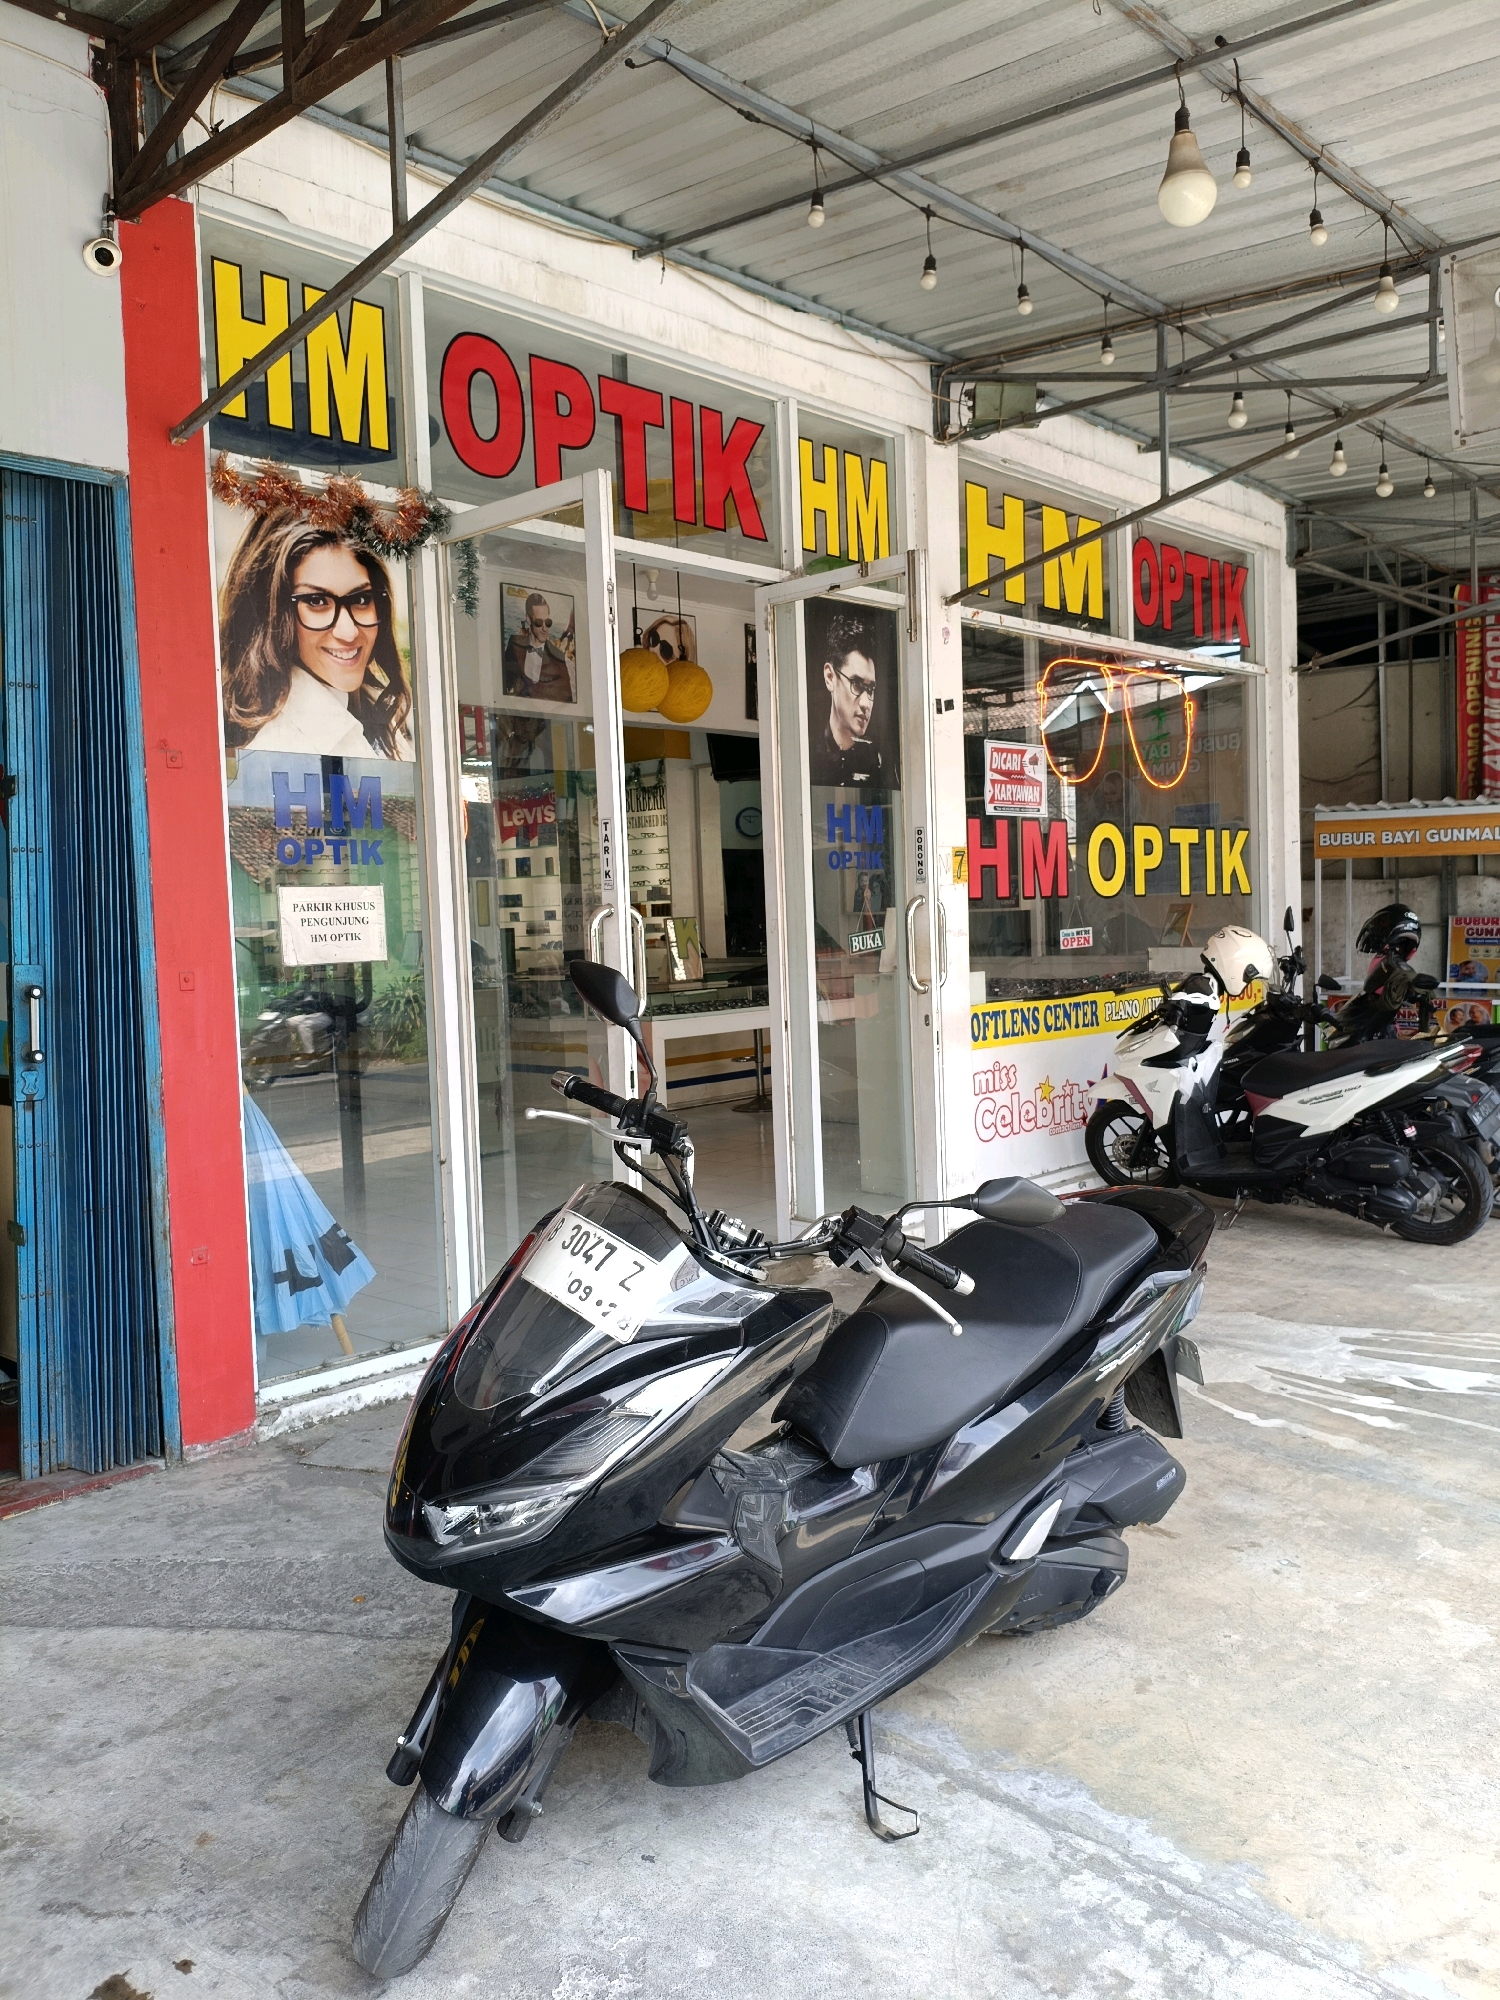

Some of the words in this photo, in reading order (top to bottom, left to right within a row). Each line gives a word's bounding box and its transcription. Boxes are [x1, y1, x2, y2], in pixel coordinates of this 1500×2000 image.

[211, 255, 391, 453] HM
[440, 332, 768, 542] OPTIK
[799, 436, 890, 563] HM
[965, 480, 1104, 620] HM
[1132, 536, 1250, 647] OPTIK
[991, 751, 1021, 771] DICARI
[271, 771, 384, 830] HM
[994, 783, 1040, 802] KARYAWAN
[826, 803, 883, 844] HM
[1319, 832, 1377, 847] BUBUR
[1381, 829, 1420, 845] BAYI
[277, 838, 384, 866] OPTIK
[603, 822, 612, 879] TARIK
[828, 850, 884, 870] OPTIK
[954, 850, 966, 880] 7
[966, 817, 1069, 901] HM
[1087, 820, 1252, 899] OPTIK
[292, 902, 332, 912] PARKIR
[334, 901, 376, 911] KHUSUS
[300, 916, 369, 927] PENGUNJUNG
[310, 934, 327, 943] HM
[330, 933, 361, 942] OPTIK
[851, 933, 883, 952] BUKA
[1062, 936, 1091, 948] OPEN
[1043, 1000, 1100, 1033] CENTER
[1104, 999, 1140, 1022] PLANO
[973, 1061, 1017, 1096] miss
[975, 1079, 1099, 1143] Celebrity
[561, 1223, 618, 1272] 3047
[619, 1260, 646, 1292] Z
